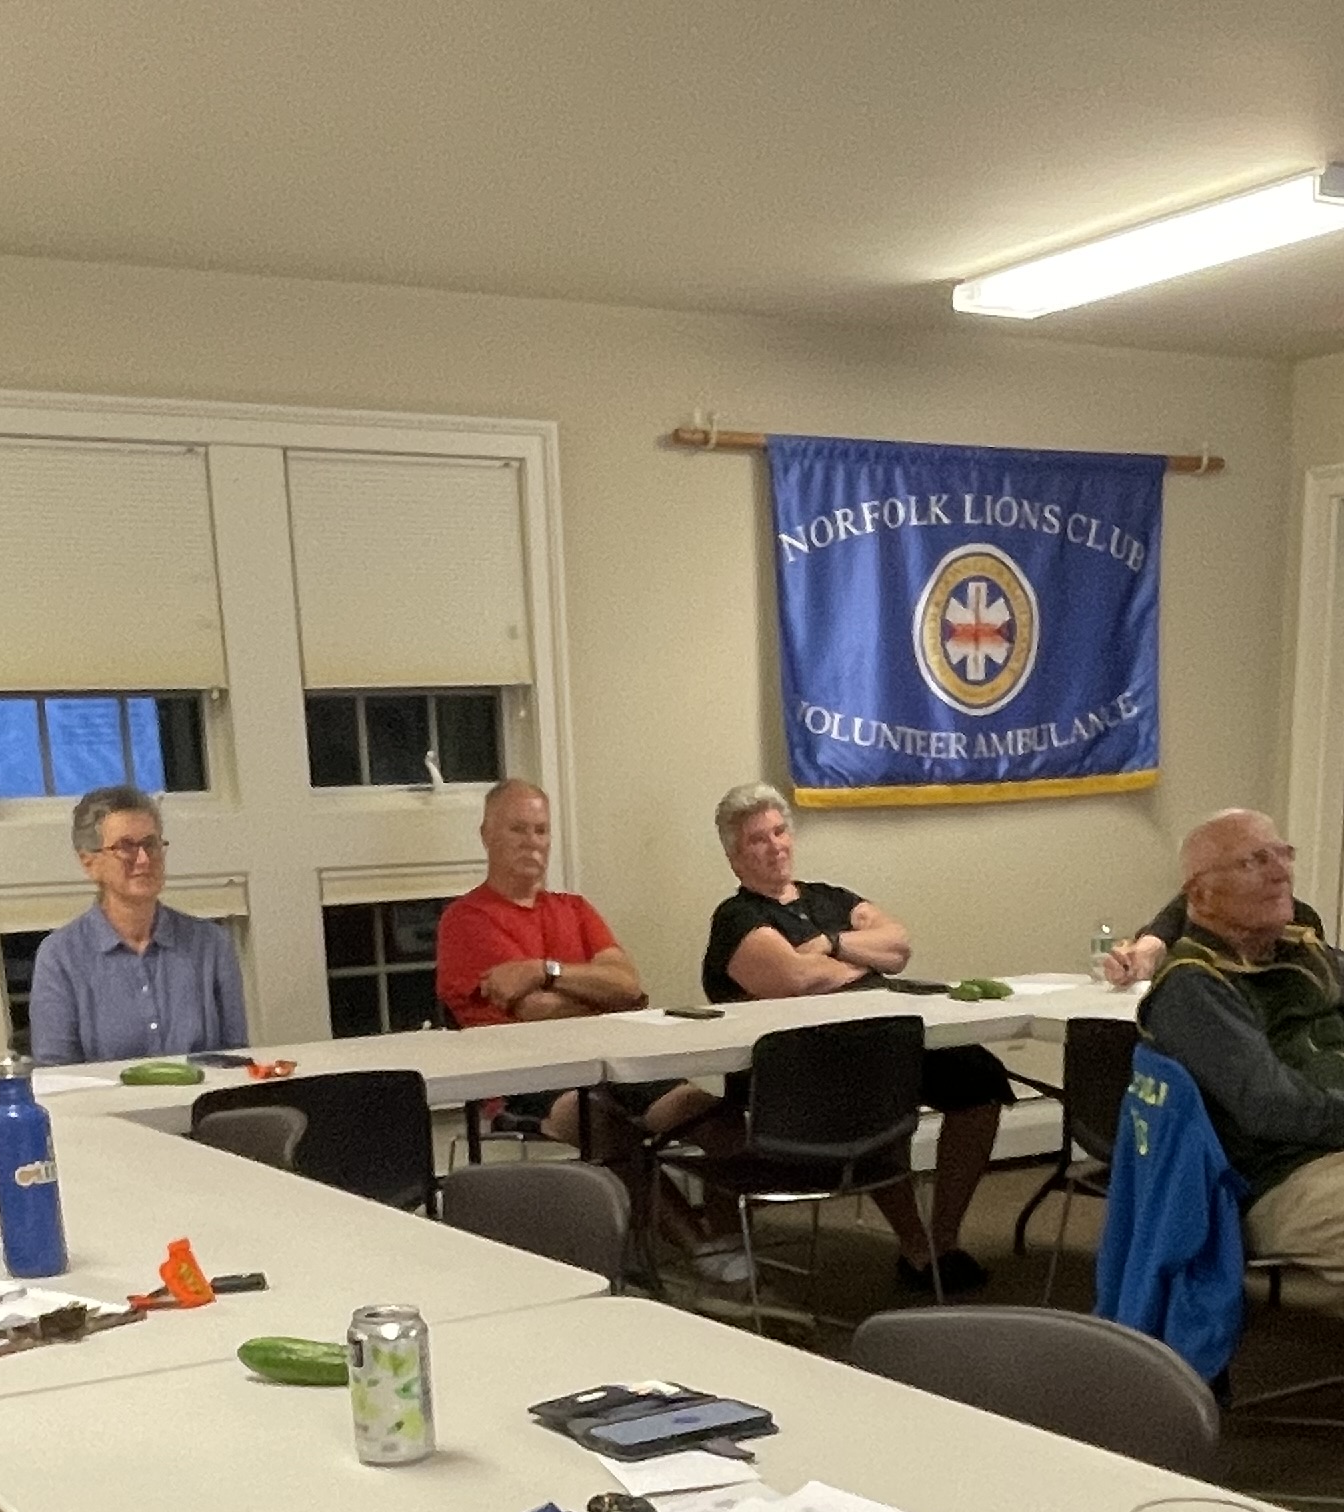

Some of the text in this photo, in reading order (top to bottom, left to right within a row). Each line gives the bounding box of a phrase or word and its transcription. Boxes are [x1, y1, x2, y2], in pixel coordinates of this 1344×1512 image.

[779, 493, 1146, 573] NORFOLK LIONS CLUB
